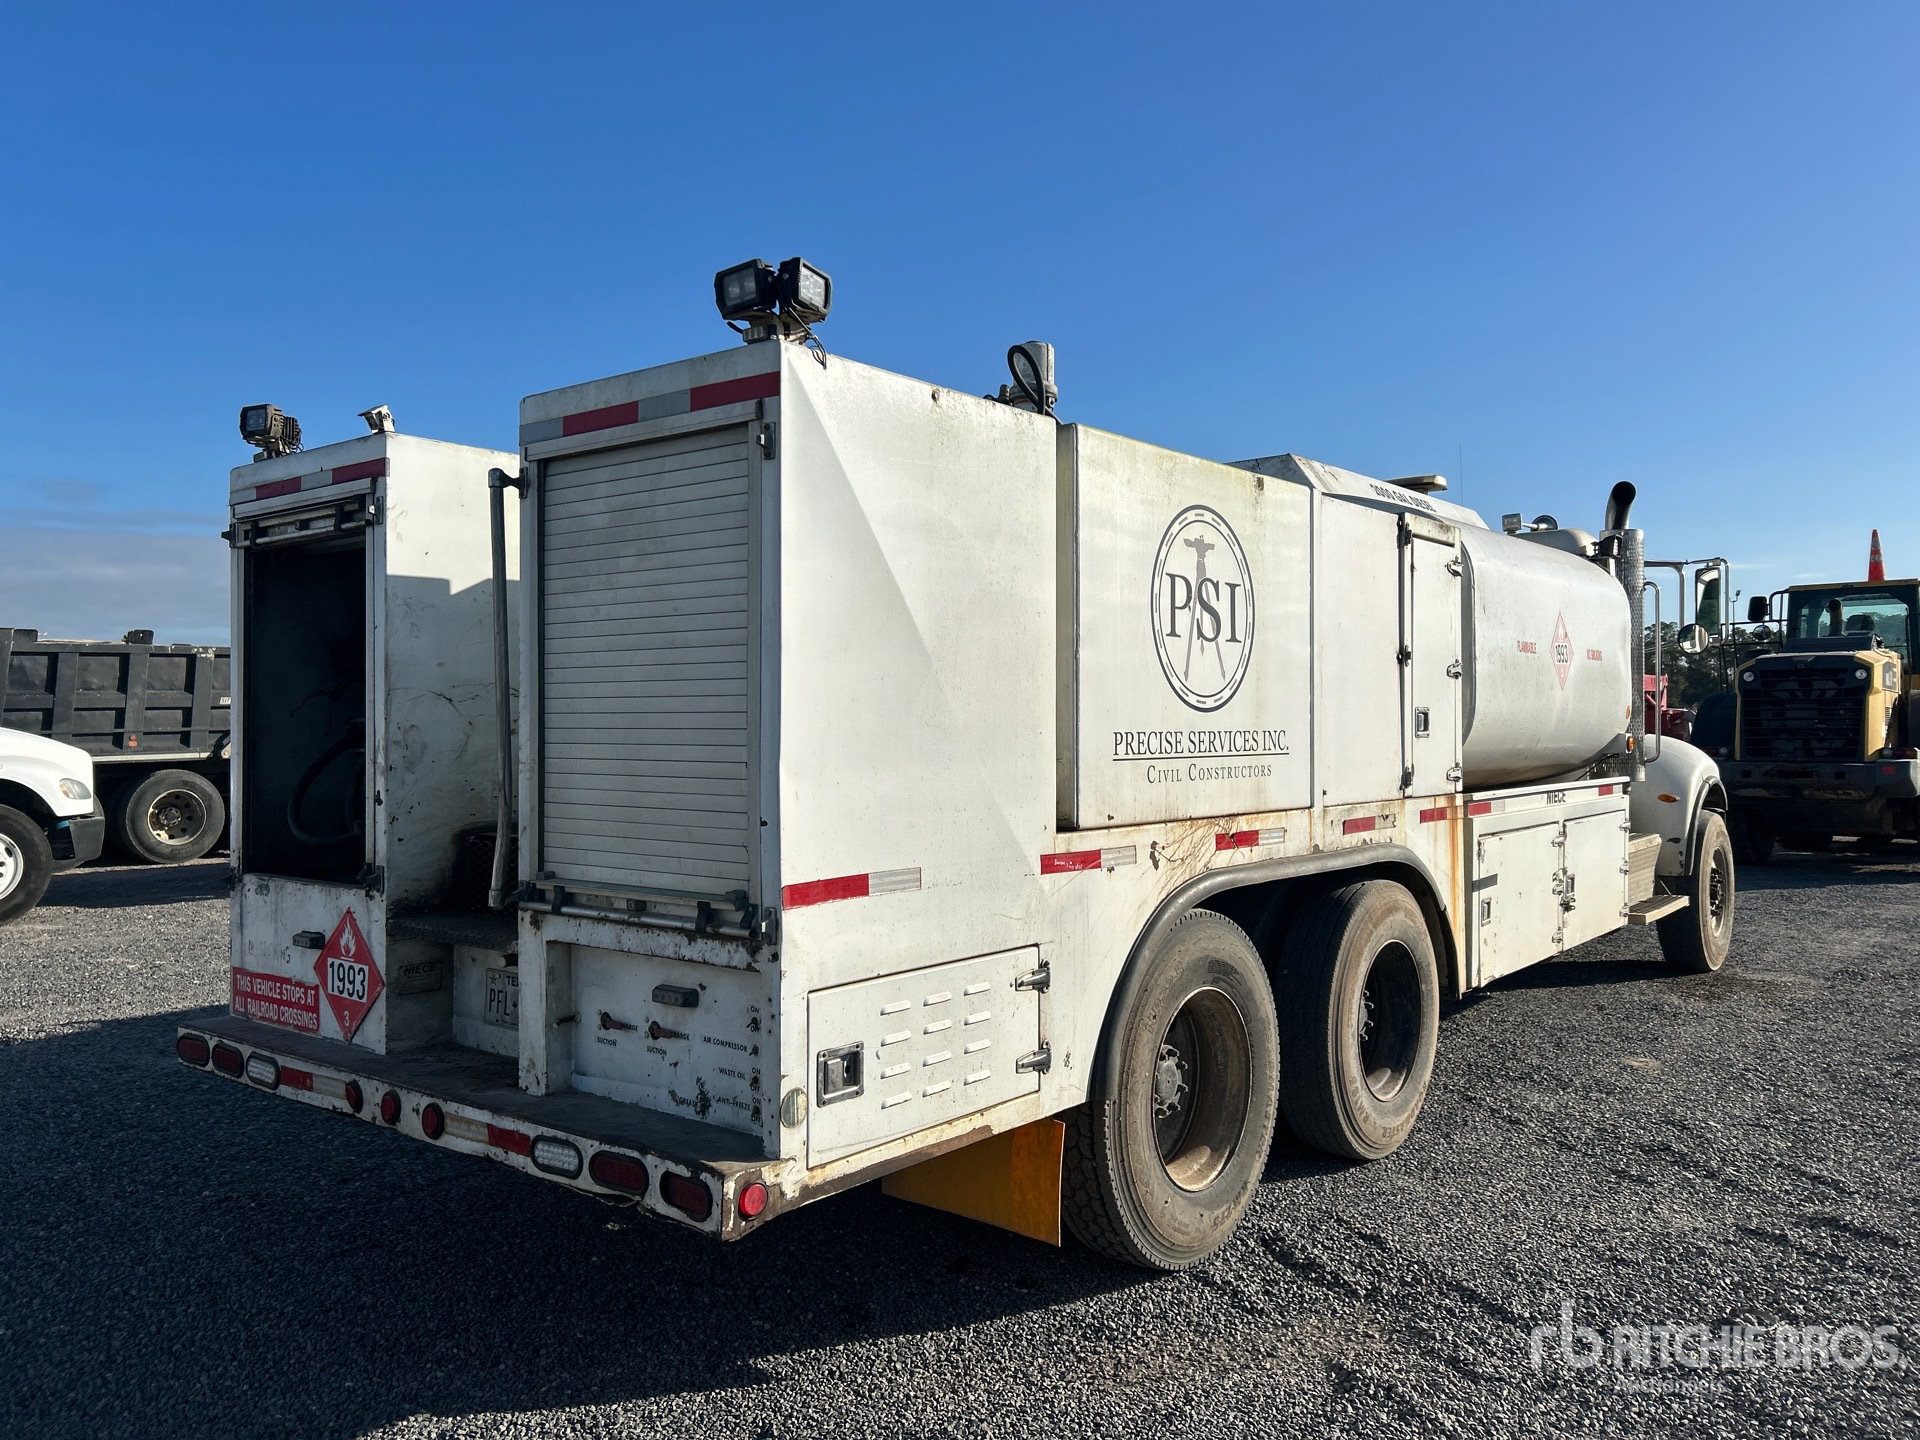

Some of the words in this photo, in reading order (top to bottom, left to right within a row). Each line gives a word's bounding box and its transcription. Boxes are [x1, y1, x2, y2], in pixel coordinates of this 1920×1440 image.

[1392, 490, 1414, 506] GAL
[1165, 572, 1242, 644] PSI
[1555, 644, 1568, 664] 1993
[1113, 731, 1184, 756] PRECISE
[1187, 730, 1260, 754] SERVICES
[1262, 729, 1290, 751] INC.
[404, 962, 436, 976] NIECE
[329, 960, 367, 1001] 1993
[236, 974, 251, 993] THIS
[252, 978, 280, 1000] VEHICLE
[282, 983, 305, 1004] STOPS
[306, 989, 315, 1007] AT
[235, 996, 245, 1012] ALL
[247, 998, 278, 1020] RAILROAD
[280, 1005, 318, 1030] CROSSINGS
[750, 1005, 760, 1013] ON
[343, 1011, 350, 1027] 3
[597, 1036, 617, 1047] SUCTION
[703, 1036, 712, 1045] AIR
[713, 1037, 747, 1052] COMPRESSOR
[646, 1045, 667, 1056] SUCTION
[719, 1067, 735, 1079] WASTE
[736, 1071, 746, 1080] OIL
[751, 1067, 761, 1075] ON
[716, 1096, 751, 1110] ANTI-FREEZE
[752, 1096, 761, 1105] ON
